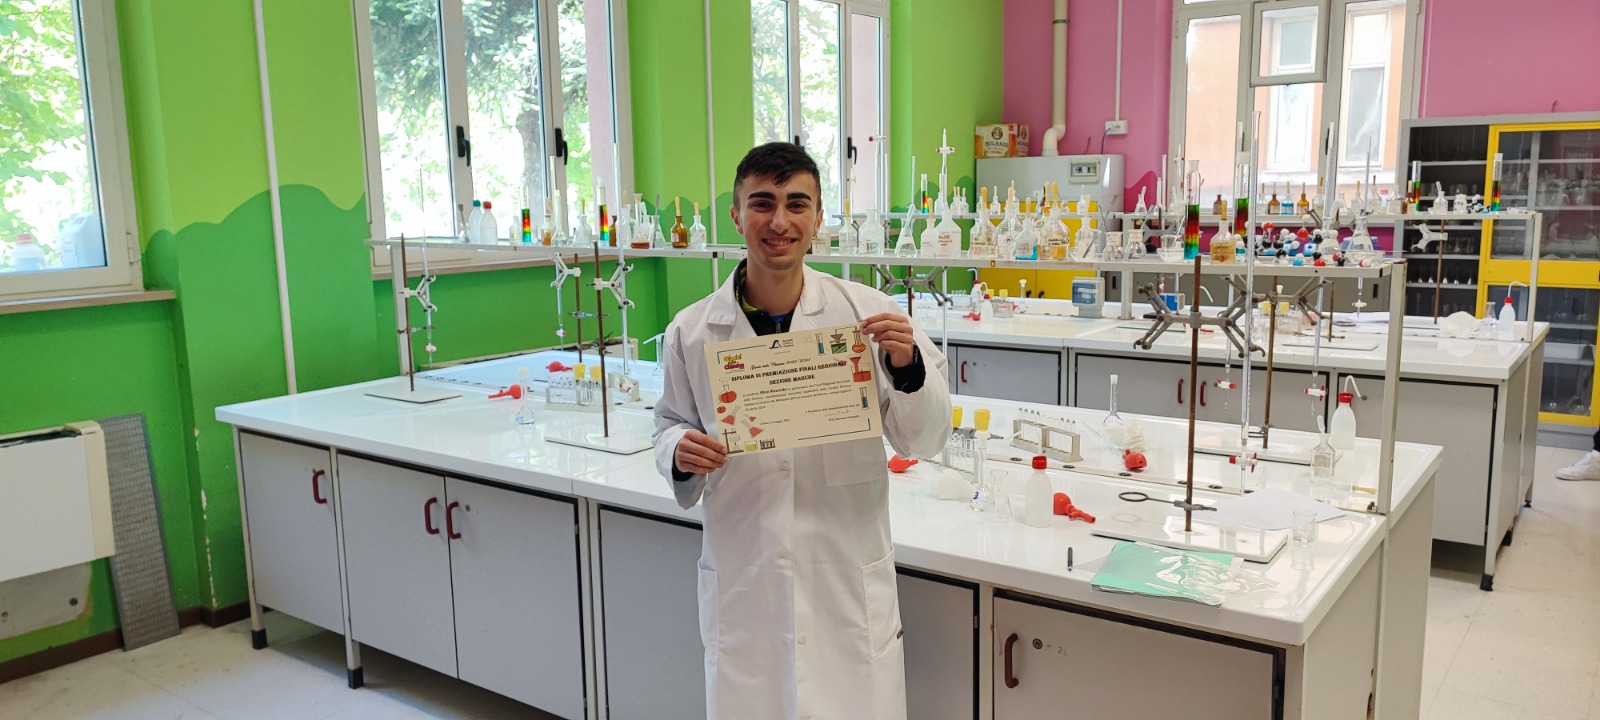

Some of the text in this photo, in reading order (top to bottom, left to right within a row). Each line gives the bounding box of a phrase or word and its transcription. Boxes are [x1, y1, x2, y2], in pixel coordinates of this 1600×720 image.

[731, 373, 755, 382] DIPLOMA
[762, 367, 798, 377] PREMIAZIONE
[769, 377, 792, 385] SEZIONE
